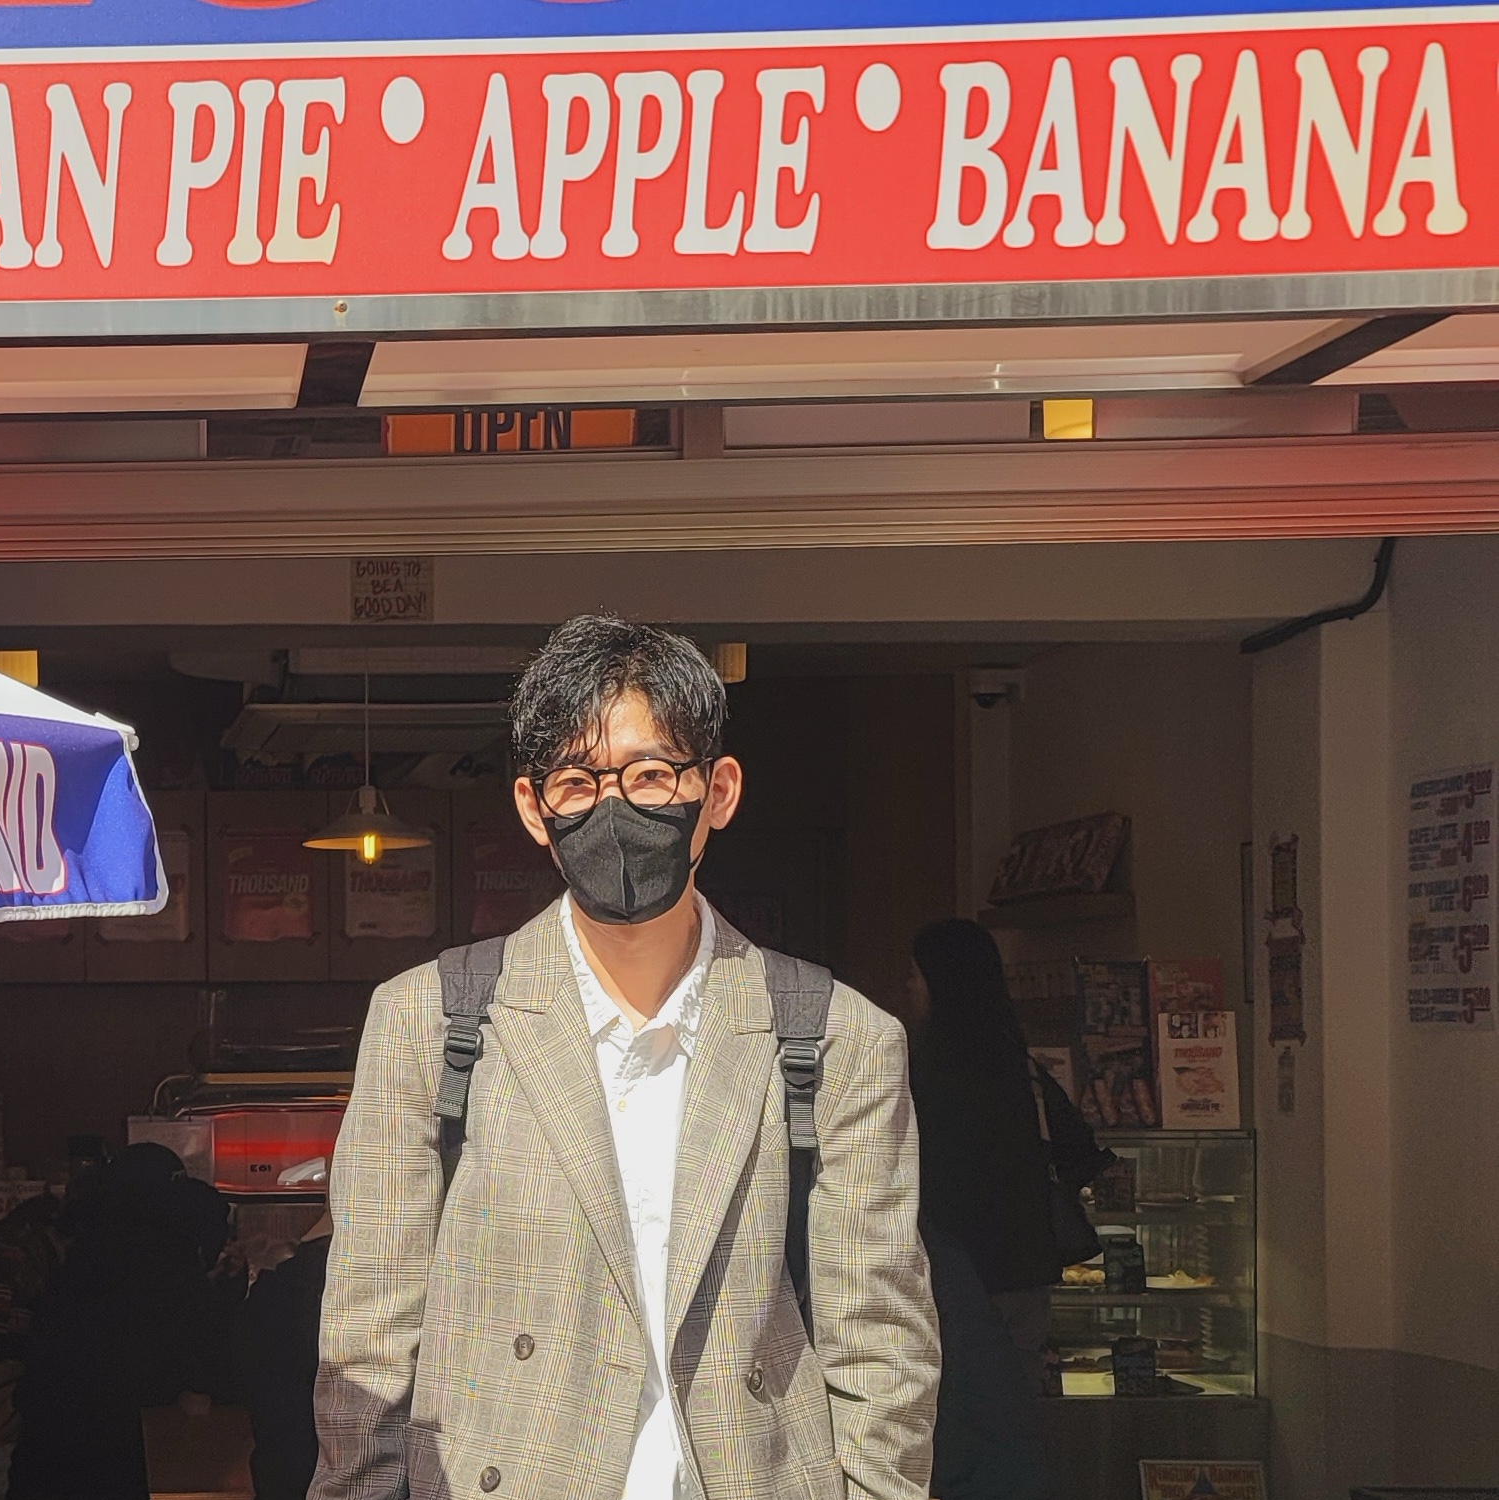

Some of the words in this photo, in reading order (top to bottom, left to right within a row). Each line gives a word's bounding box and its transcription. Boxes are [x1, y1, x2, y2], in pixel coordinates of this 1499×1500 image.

[156, 76, 346, 267] PIE
[441, 65, 825, 260] APPLE
[926, 42, 1469, 250] BANANA
[356, 561, 400, 576] GOING
[404, 561, 421, 576] TO
[371, 579, 391, 595] BE
[394, 578, 403, 592] A
[354, 597, 393, 617] GOOD
[228, 874, 310, 895] THOUSAND
[250, 1163, 272, 1172] E61
